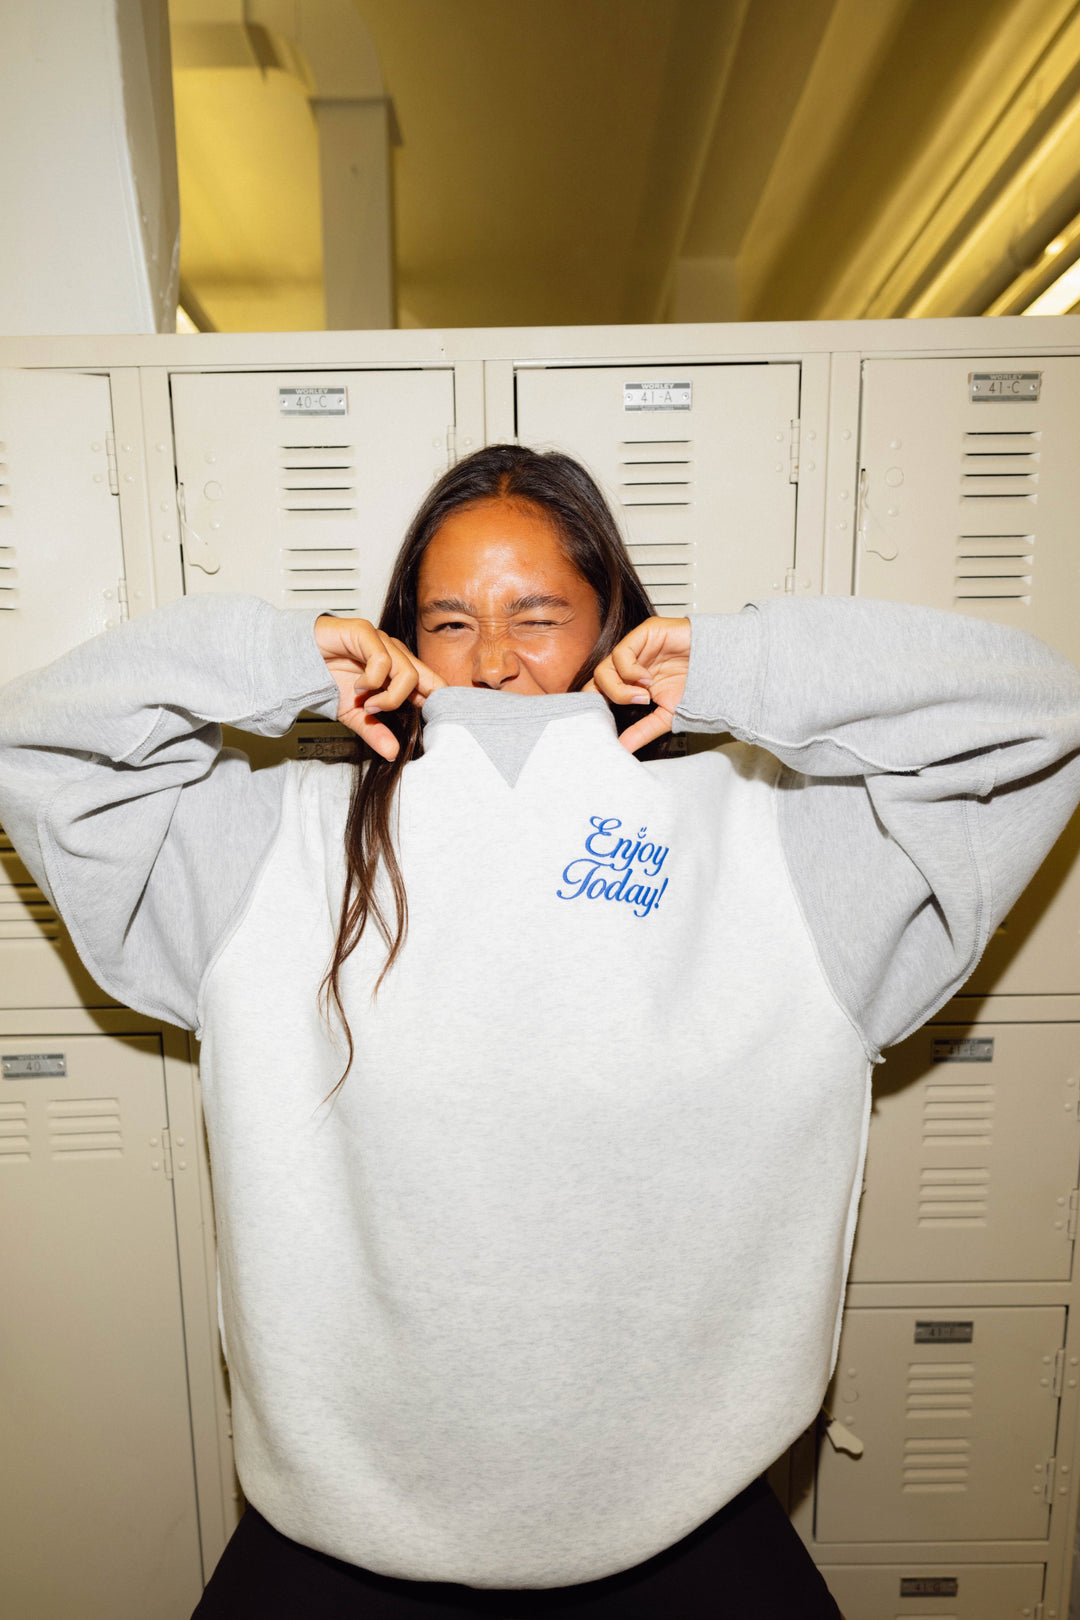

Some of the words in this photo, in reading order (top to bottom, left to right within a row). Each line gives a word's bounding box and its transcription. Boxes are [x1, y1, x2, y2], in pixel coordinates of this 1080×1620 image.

[989, 381, 1020, 394] 41-C
[296, 395, 327, 408] 40-C
[641, 390, 672, 404] 41-A
[585, 816, 669, 876] Enjoy
[556, 858, 668, 917] Today!
[26, 1061, 41, 1071] 40
